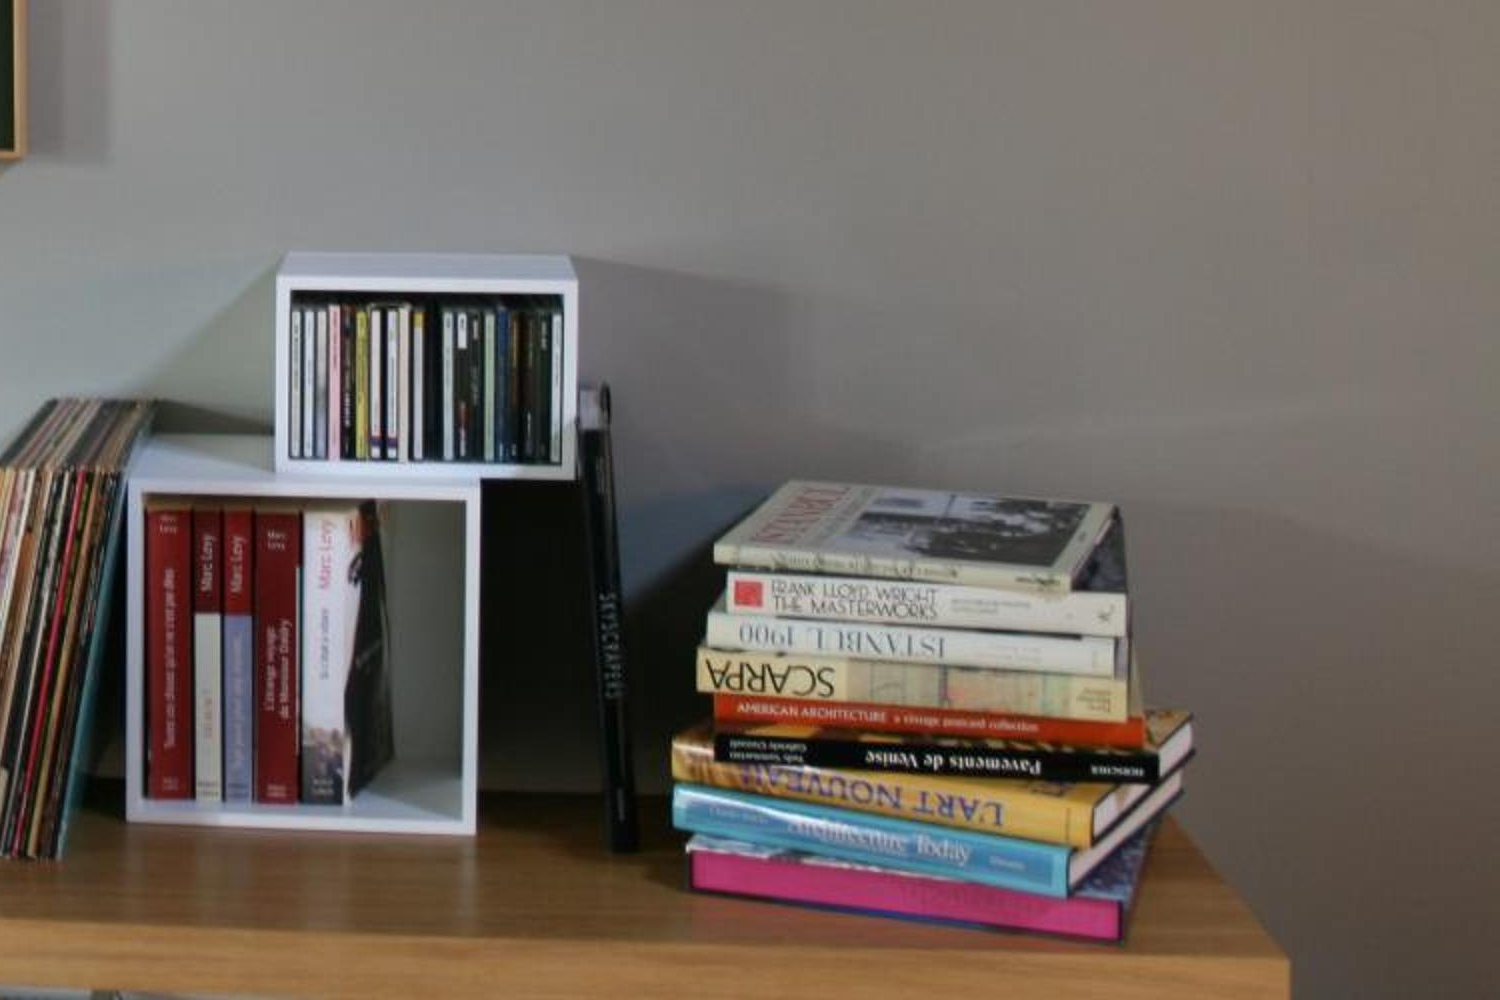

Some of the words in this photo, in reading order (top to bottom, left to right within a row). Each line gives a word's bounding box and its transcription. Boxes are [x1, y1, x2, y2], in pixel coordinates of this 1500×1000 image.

[771, 579, 813, 597] FRANK
[823, 581, 868, 598] LLOYD
[875, 585, 938, 603] WRIGHT
[773, 596, 802, 612] THE
[811, 599, 938, 620] MASTERWORKS
[739, 622, 793, 647] 1900
[811, 625, 944, 658] ISTANBUL
[705, 658, 835, 697] SCARPA
[737, 703, 799, 719] AMERICAN
[801, 706, 887, 723] ARCHITECTURE
[865, 749, 919, 769] Venise
[923, 753, 944, 769] de
[949, 755, 1042, 775] Pavements
[739, 763, 905, 809] NOUVEAU
[912, 790, 1005, 827] L'ART
[916, 831, 973, 867] Today
